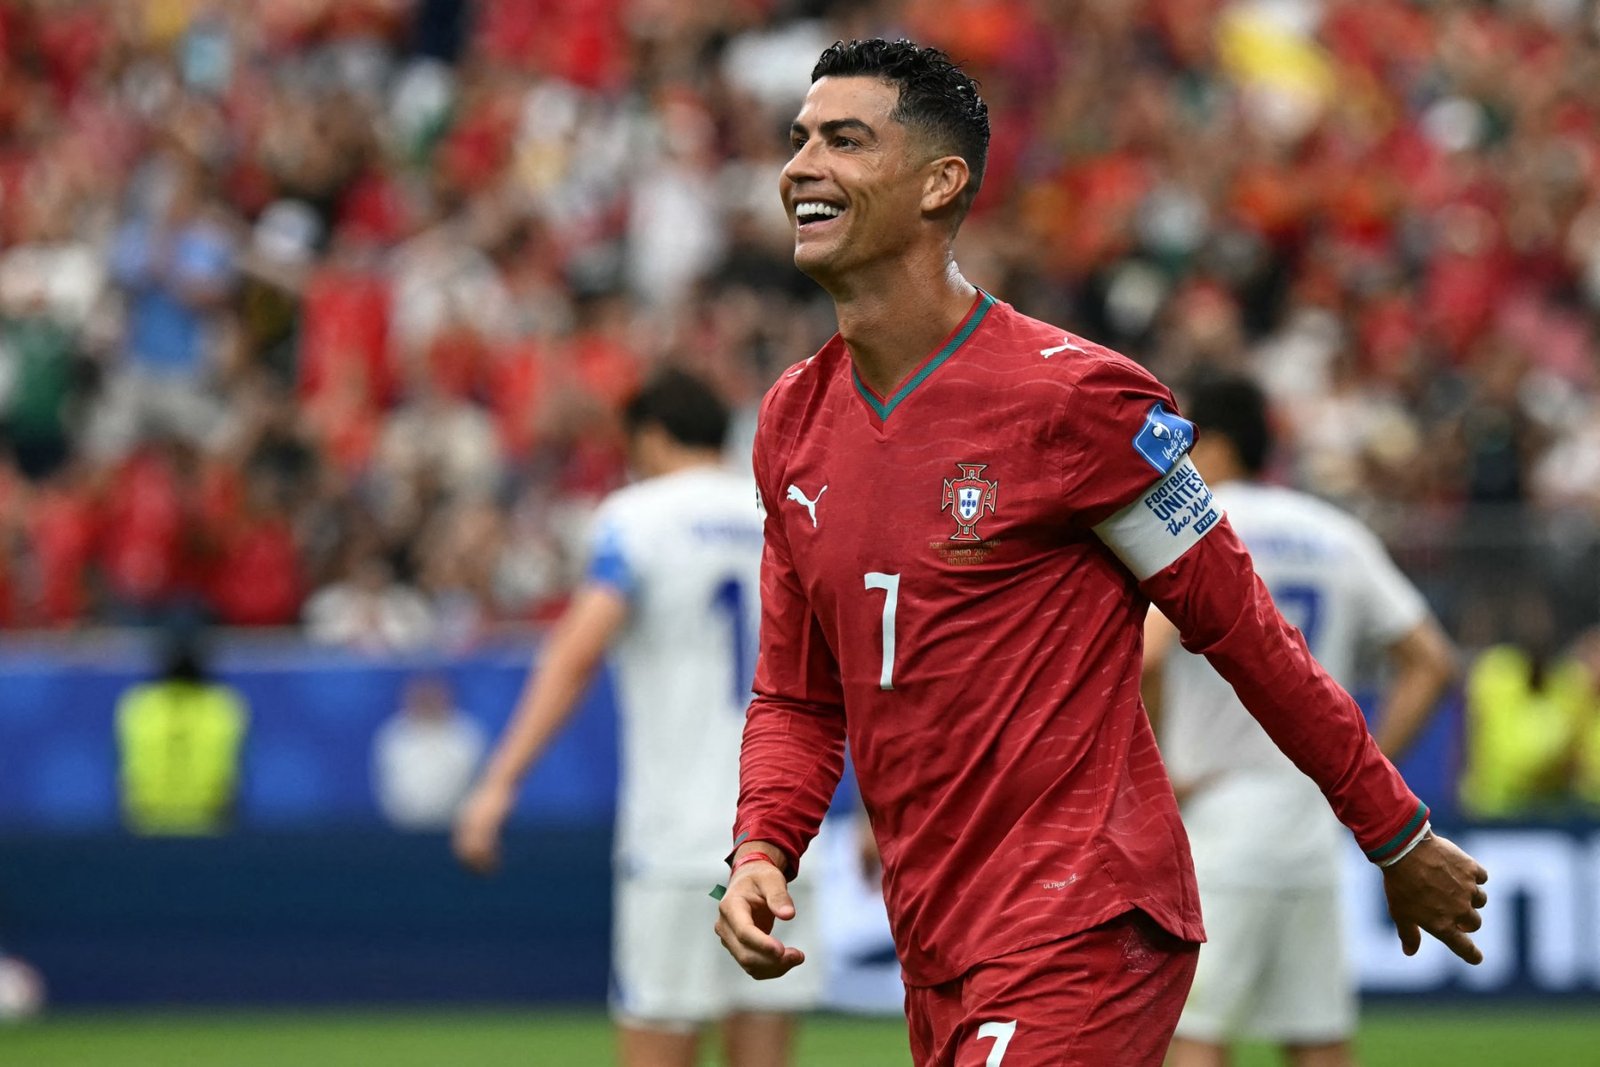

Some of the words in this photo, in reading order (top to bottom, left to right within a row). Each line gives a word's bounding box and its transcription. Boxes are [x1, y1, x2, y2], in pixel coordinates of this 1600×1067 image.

[1144, 464, 1193, 510] FOOTBALL
[1152, 472, 1204, 521] UNITES
[1165, 515, 1191, 536] the
[1195, 511, 1217, 533] FIFA
[864, 571, 900, 690] 7
[976, 1018, 1018, 1067] 7
